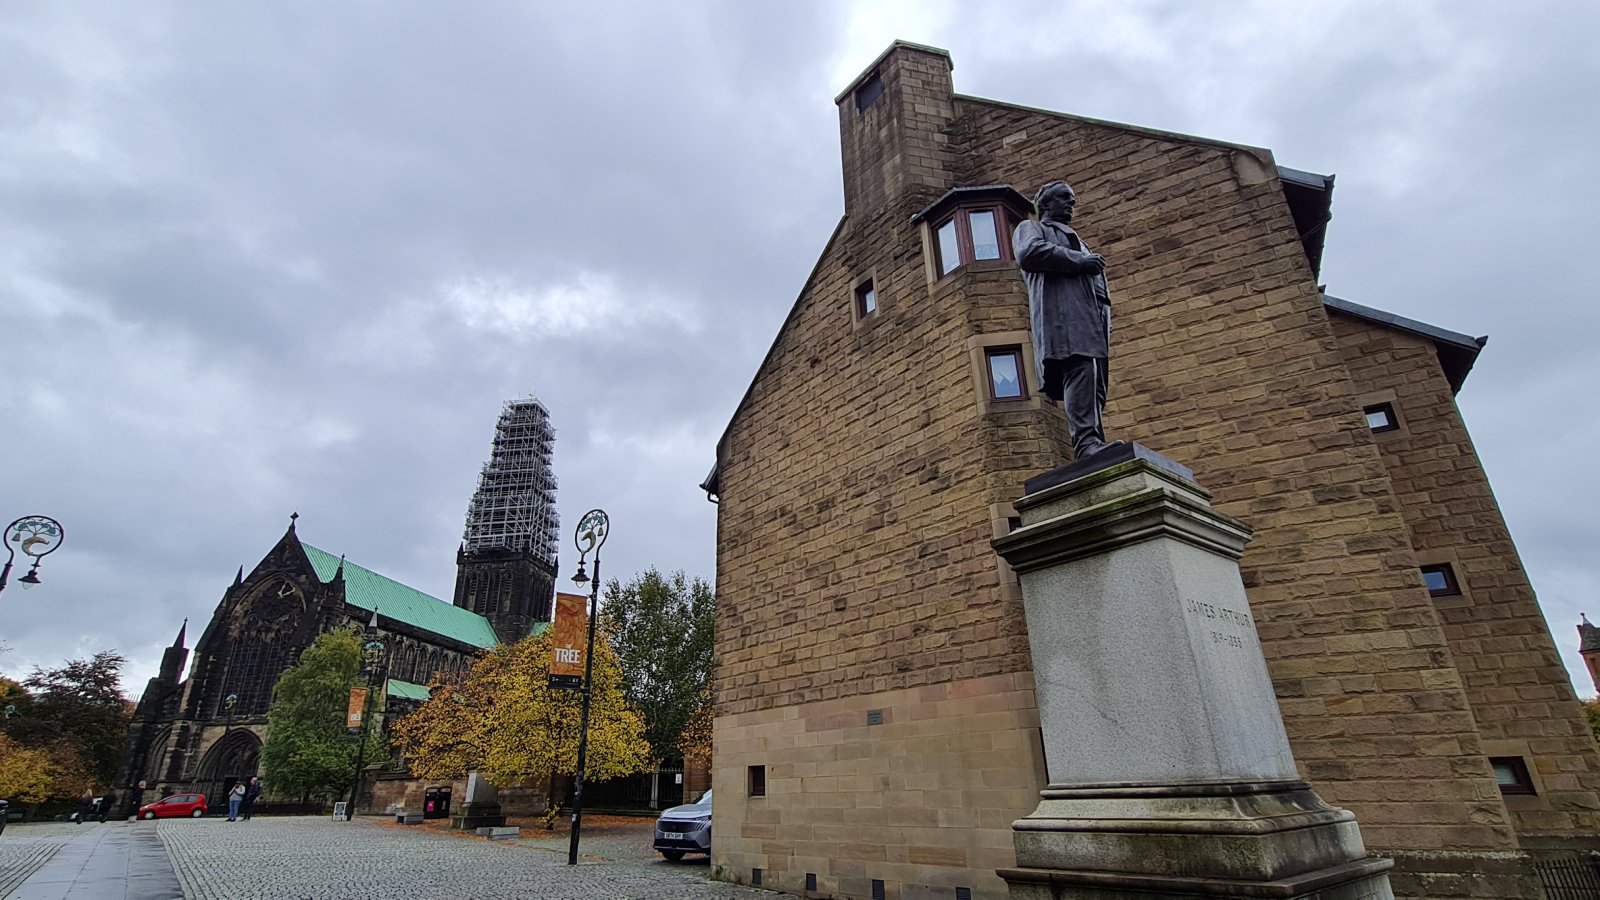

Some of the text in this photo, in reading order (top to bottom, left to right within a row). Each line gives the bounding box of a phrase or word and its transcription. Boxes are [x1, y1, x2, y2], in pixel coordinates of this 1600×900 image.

[1187, 599, 1251, 628] JAMES ARTHUR
[554, 647, 580, 663] TREE
